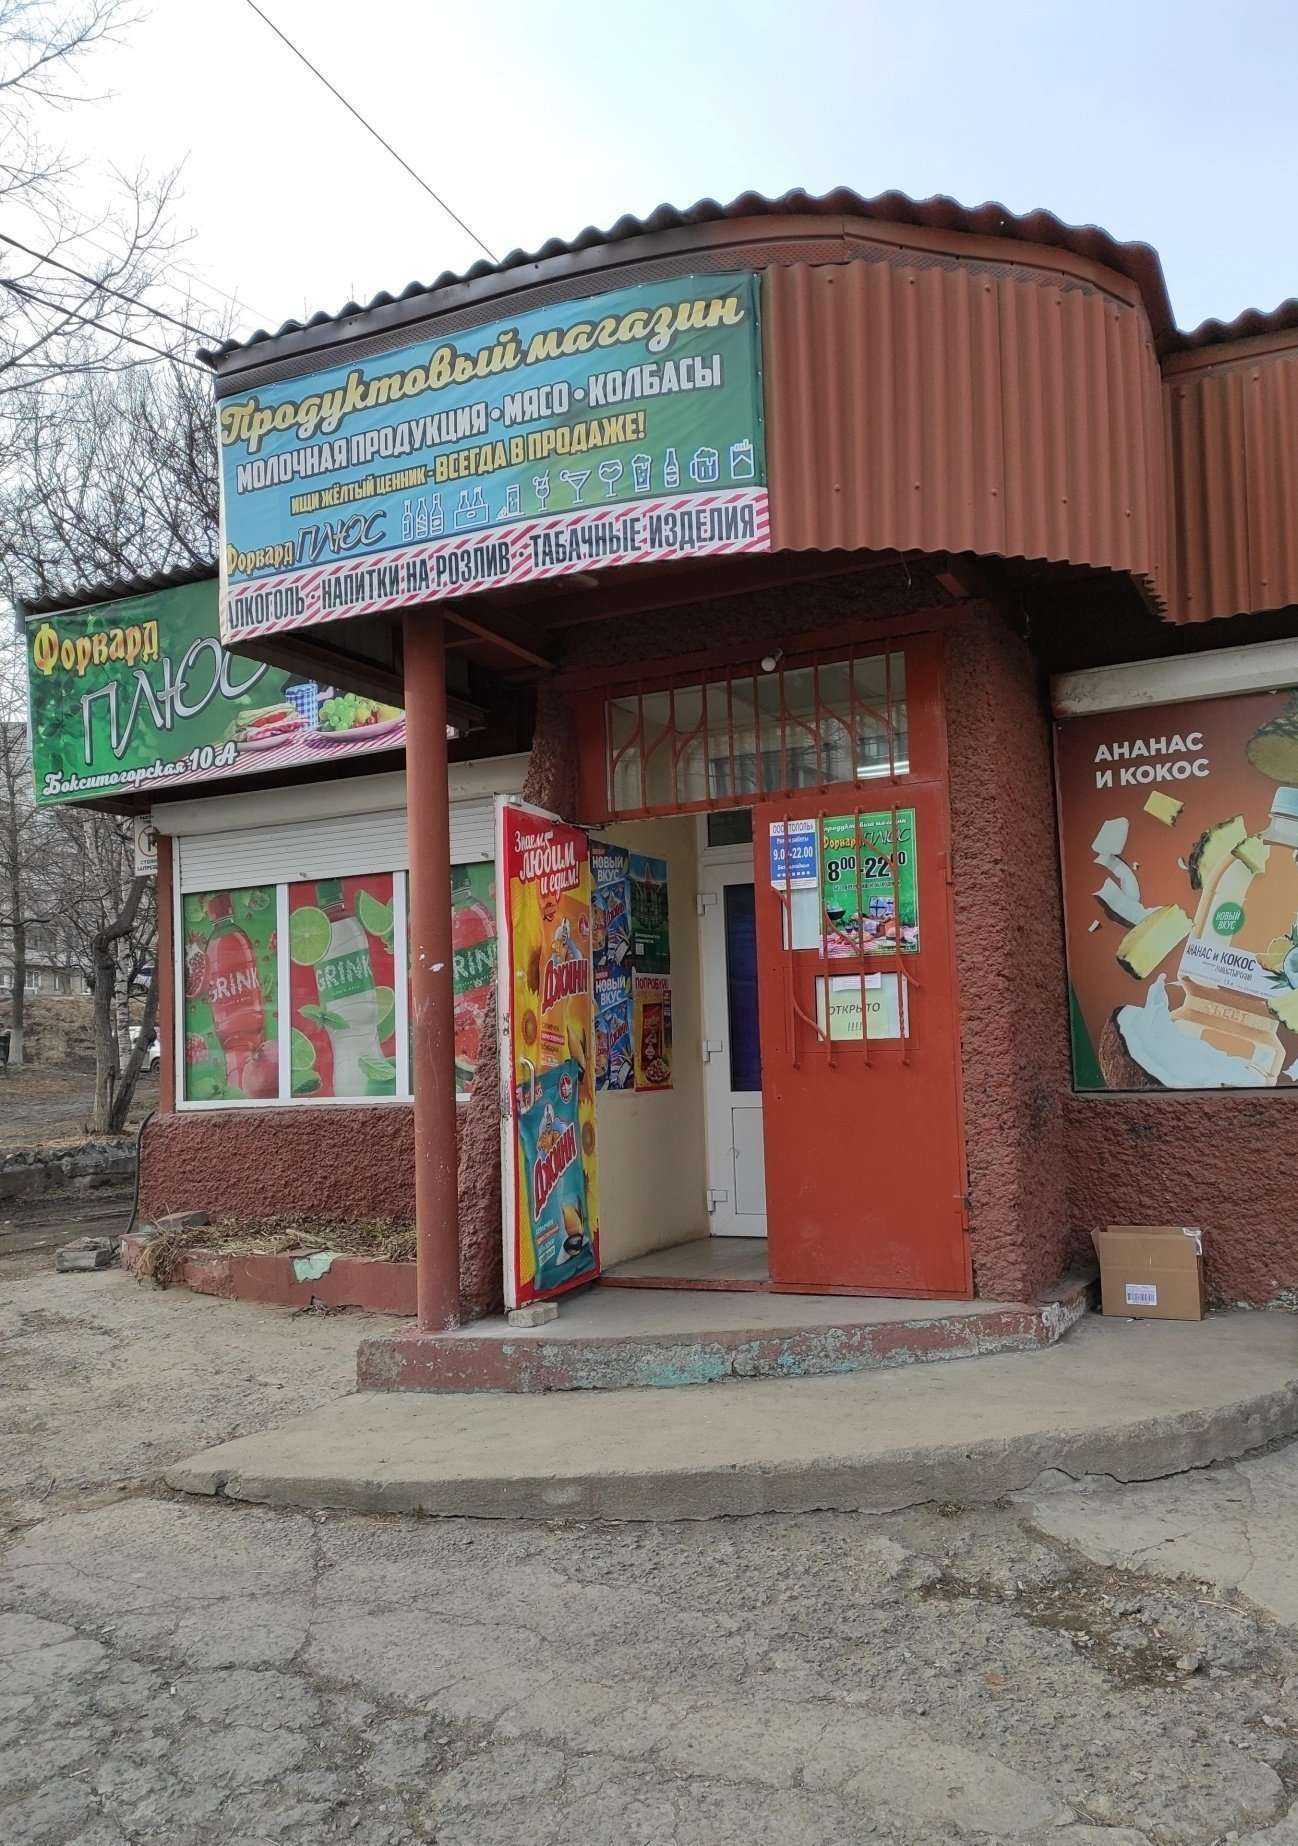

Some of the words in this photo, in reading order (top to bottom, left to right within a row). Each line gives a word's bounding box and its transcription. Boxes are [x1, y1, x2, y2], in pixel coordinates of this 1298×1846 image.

[221, 329, 521, 451] Продуктовый
[525, 296, 746, 365] магазин
[237, 439, 348, 494] МОЛОЧНАЯ
[351, 402, 487, 465] ПРОДУКЦИЯ
[504, 382, 569, 427] МЯСО
[588, 353, 722, 407] КОЛБАСЫ
[291, 492, 320, 514] ИЩИ
[321, 474, 374, 508] ЖЁЛТЫЙ
[377, 465, 427, 496] ЦЕННИК
[435, 441, 505, 484] ВСЕГДА
[511, 435, 525, 462] В
[526, 411, 646, 455] ПРОДАЖЕ!
[296, 510, 387, 563] ПЛЮС
[321, 563, 400, 610] НАПИТКИ
[406, 559, 430, 594] НА
[436, 541, 511, 588] РОЗЛИВ
[530, 516, 642, 568] ТАБАЧНЫЕ
[651, 503, 756, 551] ИЗДЕЛИЯ
[33, 620, 160, 677] Форвард
[1094, 732, 1205, 763] АНАНАС
[42, 758, 187, 797] Бокситогорская
[1095, 769, 1113, 789] И
[1120, 758, 1211, 785] КОКОС
[773, 847, 813, 861] 9.0-22.00
[597, 868, 620, 881] ВКУС
[1220, 951, 1258, 972] КОКОС
[595, 976, 626, 993] НОВЫЙ
[600, 990, 622, 1005] ВКУС
